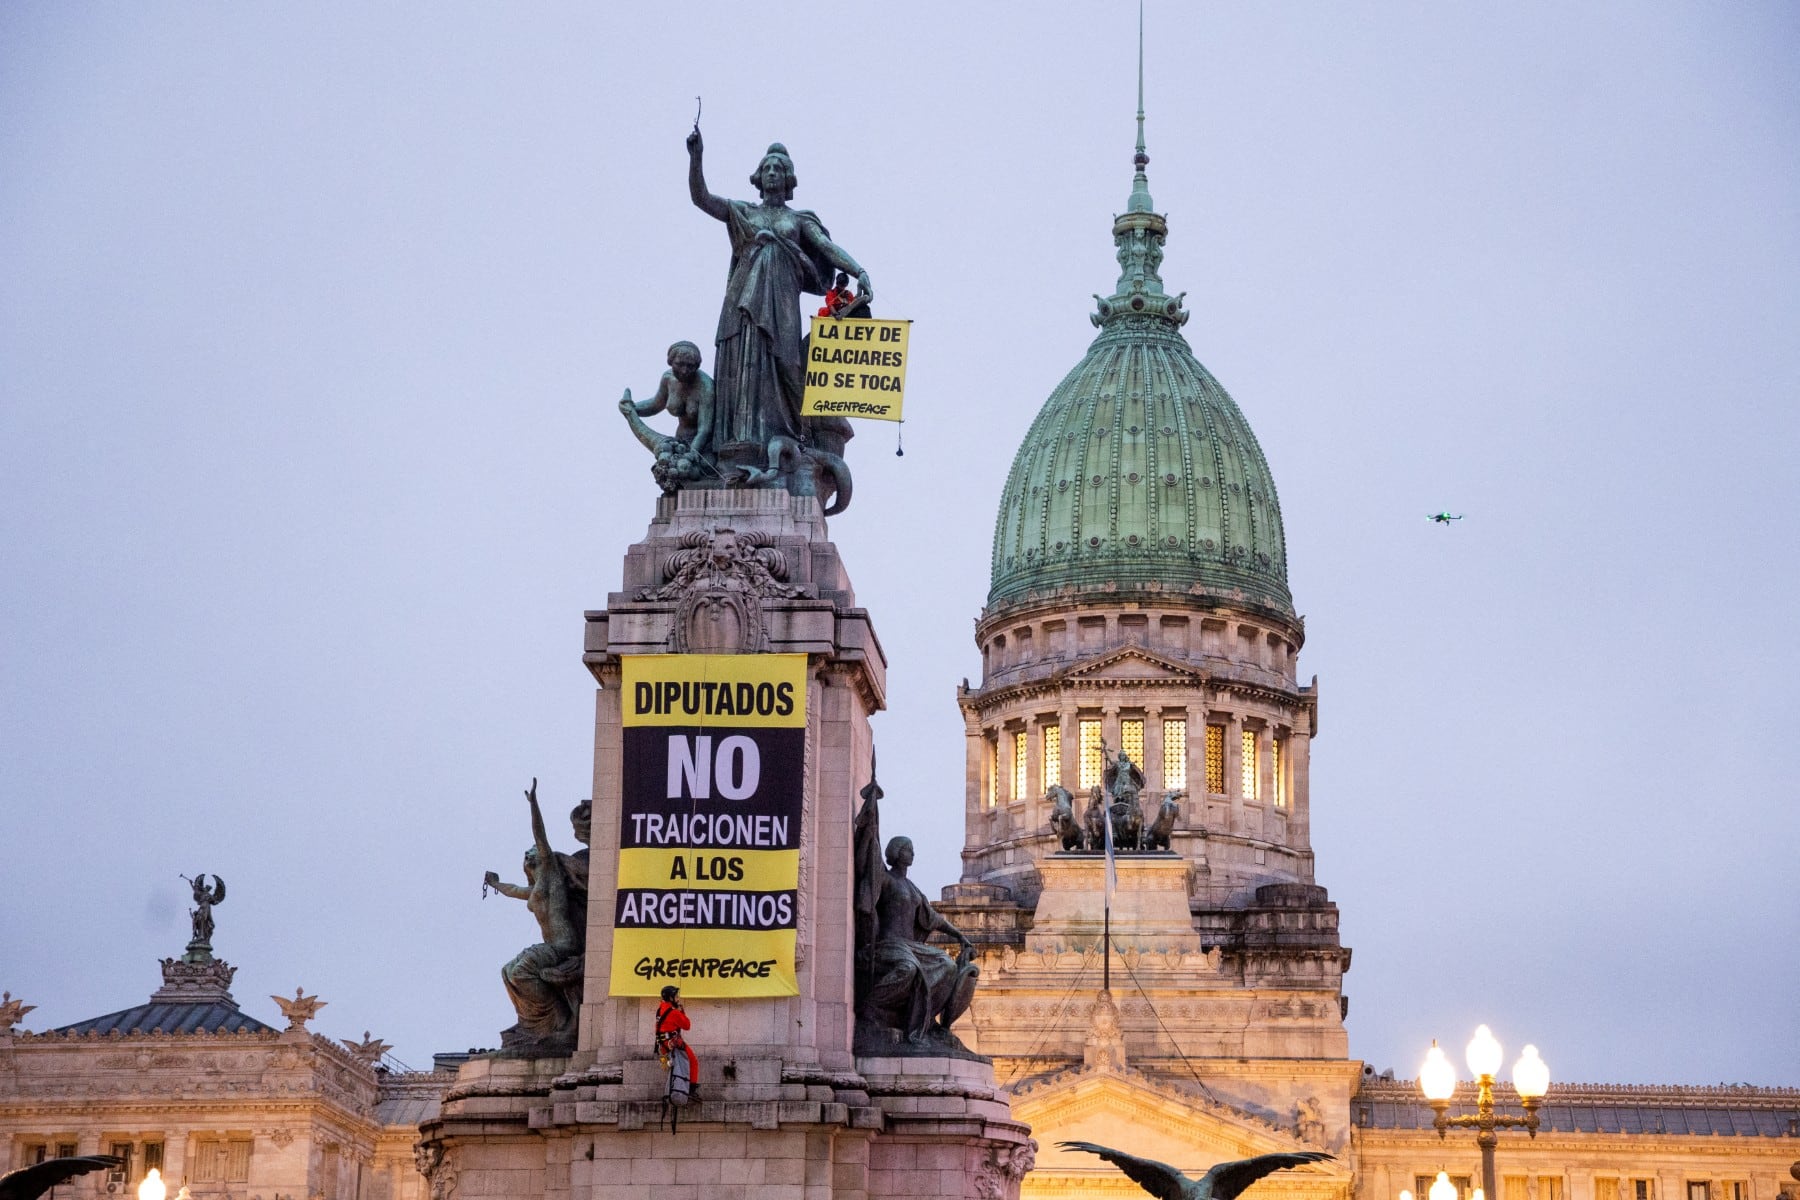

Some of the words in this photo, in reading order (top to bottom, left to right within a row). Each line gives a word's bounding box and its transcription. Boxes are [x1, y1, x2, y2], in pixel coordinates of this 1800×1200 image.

[818, 324, 839, 339] LA
[844, 326, 875, 341] LEY
[879, 327, 901, 342] DE
[811, 346, 903, 367] GLACIARES
[805, 371, 828, 387] NO
[833, 373, 855, 388] SE
[859, 374, 901, 392] TOCA
[812, 400, 891, 415] GREENPEACE
[635, 681, 794, 716] DIPUTADOS
[666, 734, 761, 800] NO
[631, 813, 788, 846] TRAICIONEN
[669, 855, 687, 880] A
[696, 856, 744, 881] LOS
[620, 892, 792, 927] ARGENTINOS
[634, 956, 777, 980] GREENPEACE
